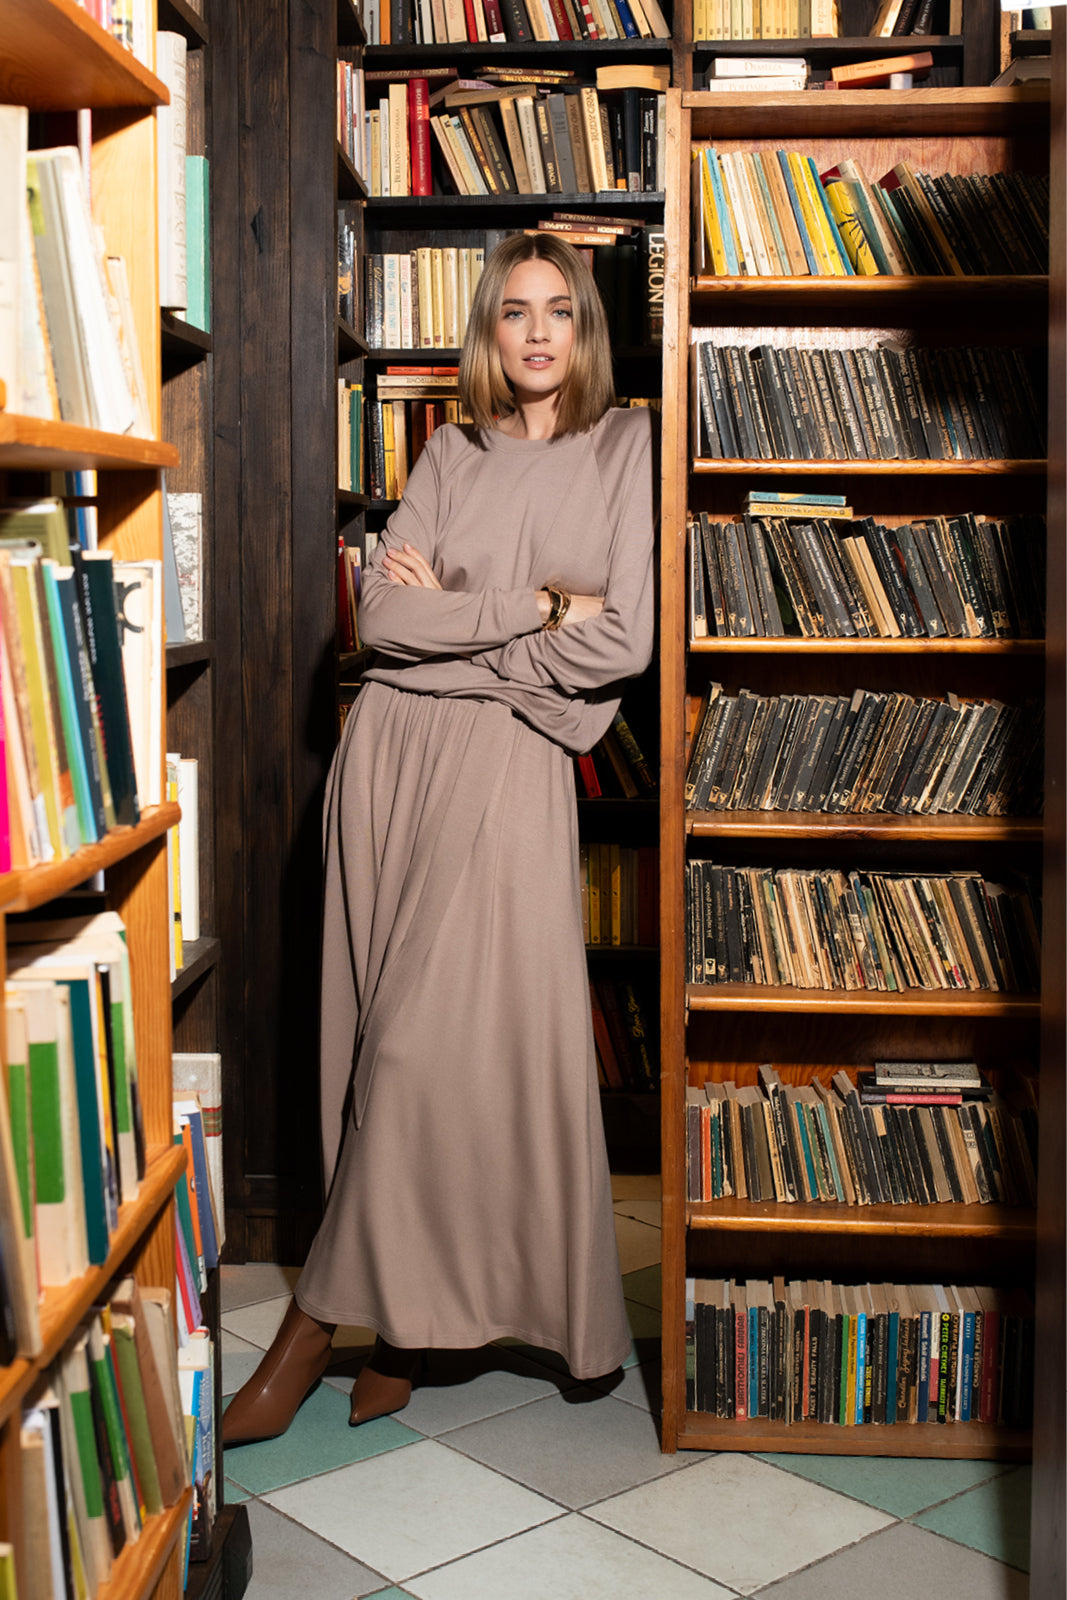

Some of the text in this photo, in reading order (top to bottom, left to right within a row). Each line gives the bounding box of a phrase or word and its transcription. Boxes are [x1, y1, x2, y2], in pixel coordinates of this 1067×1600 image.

[588, 115, 599, 142] RUDY
[597, 226, 624, 234] BUNSCH
[648, 233, 664, 302] LEGION
[737, 1315, 745, 1349] FARRAR
